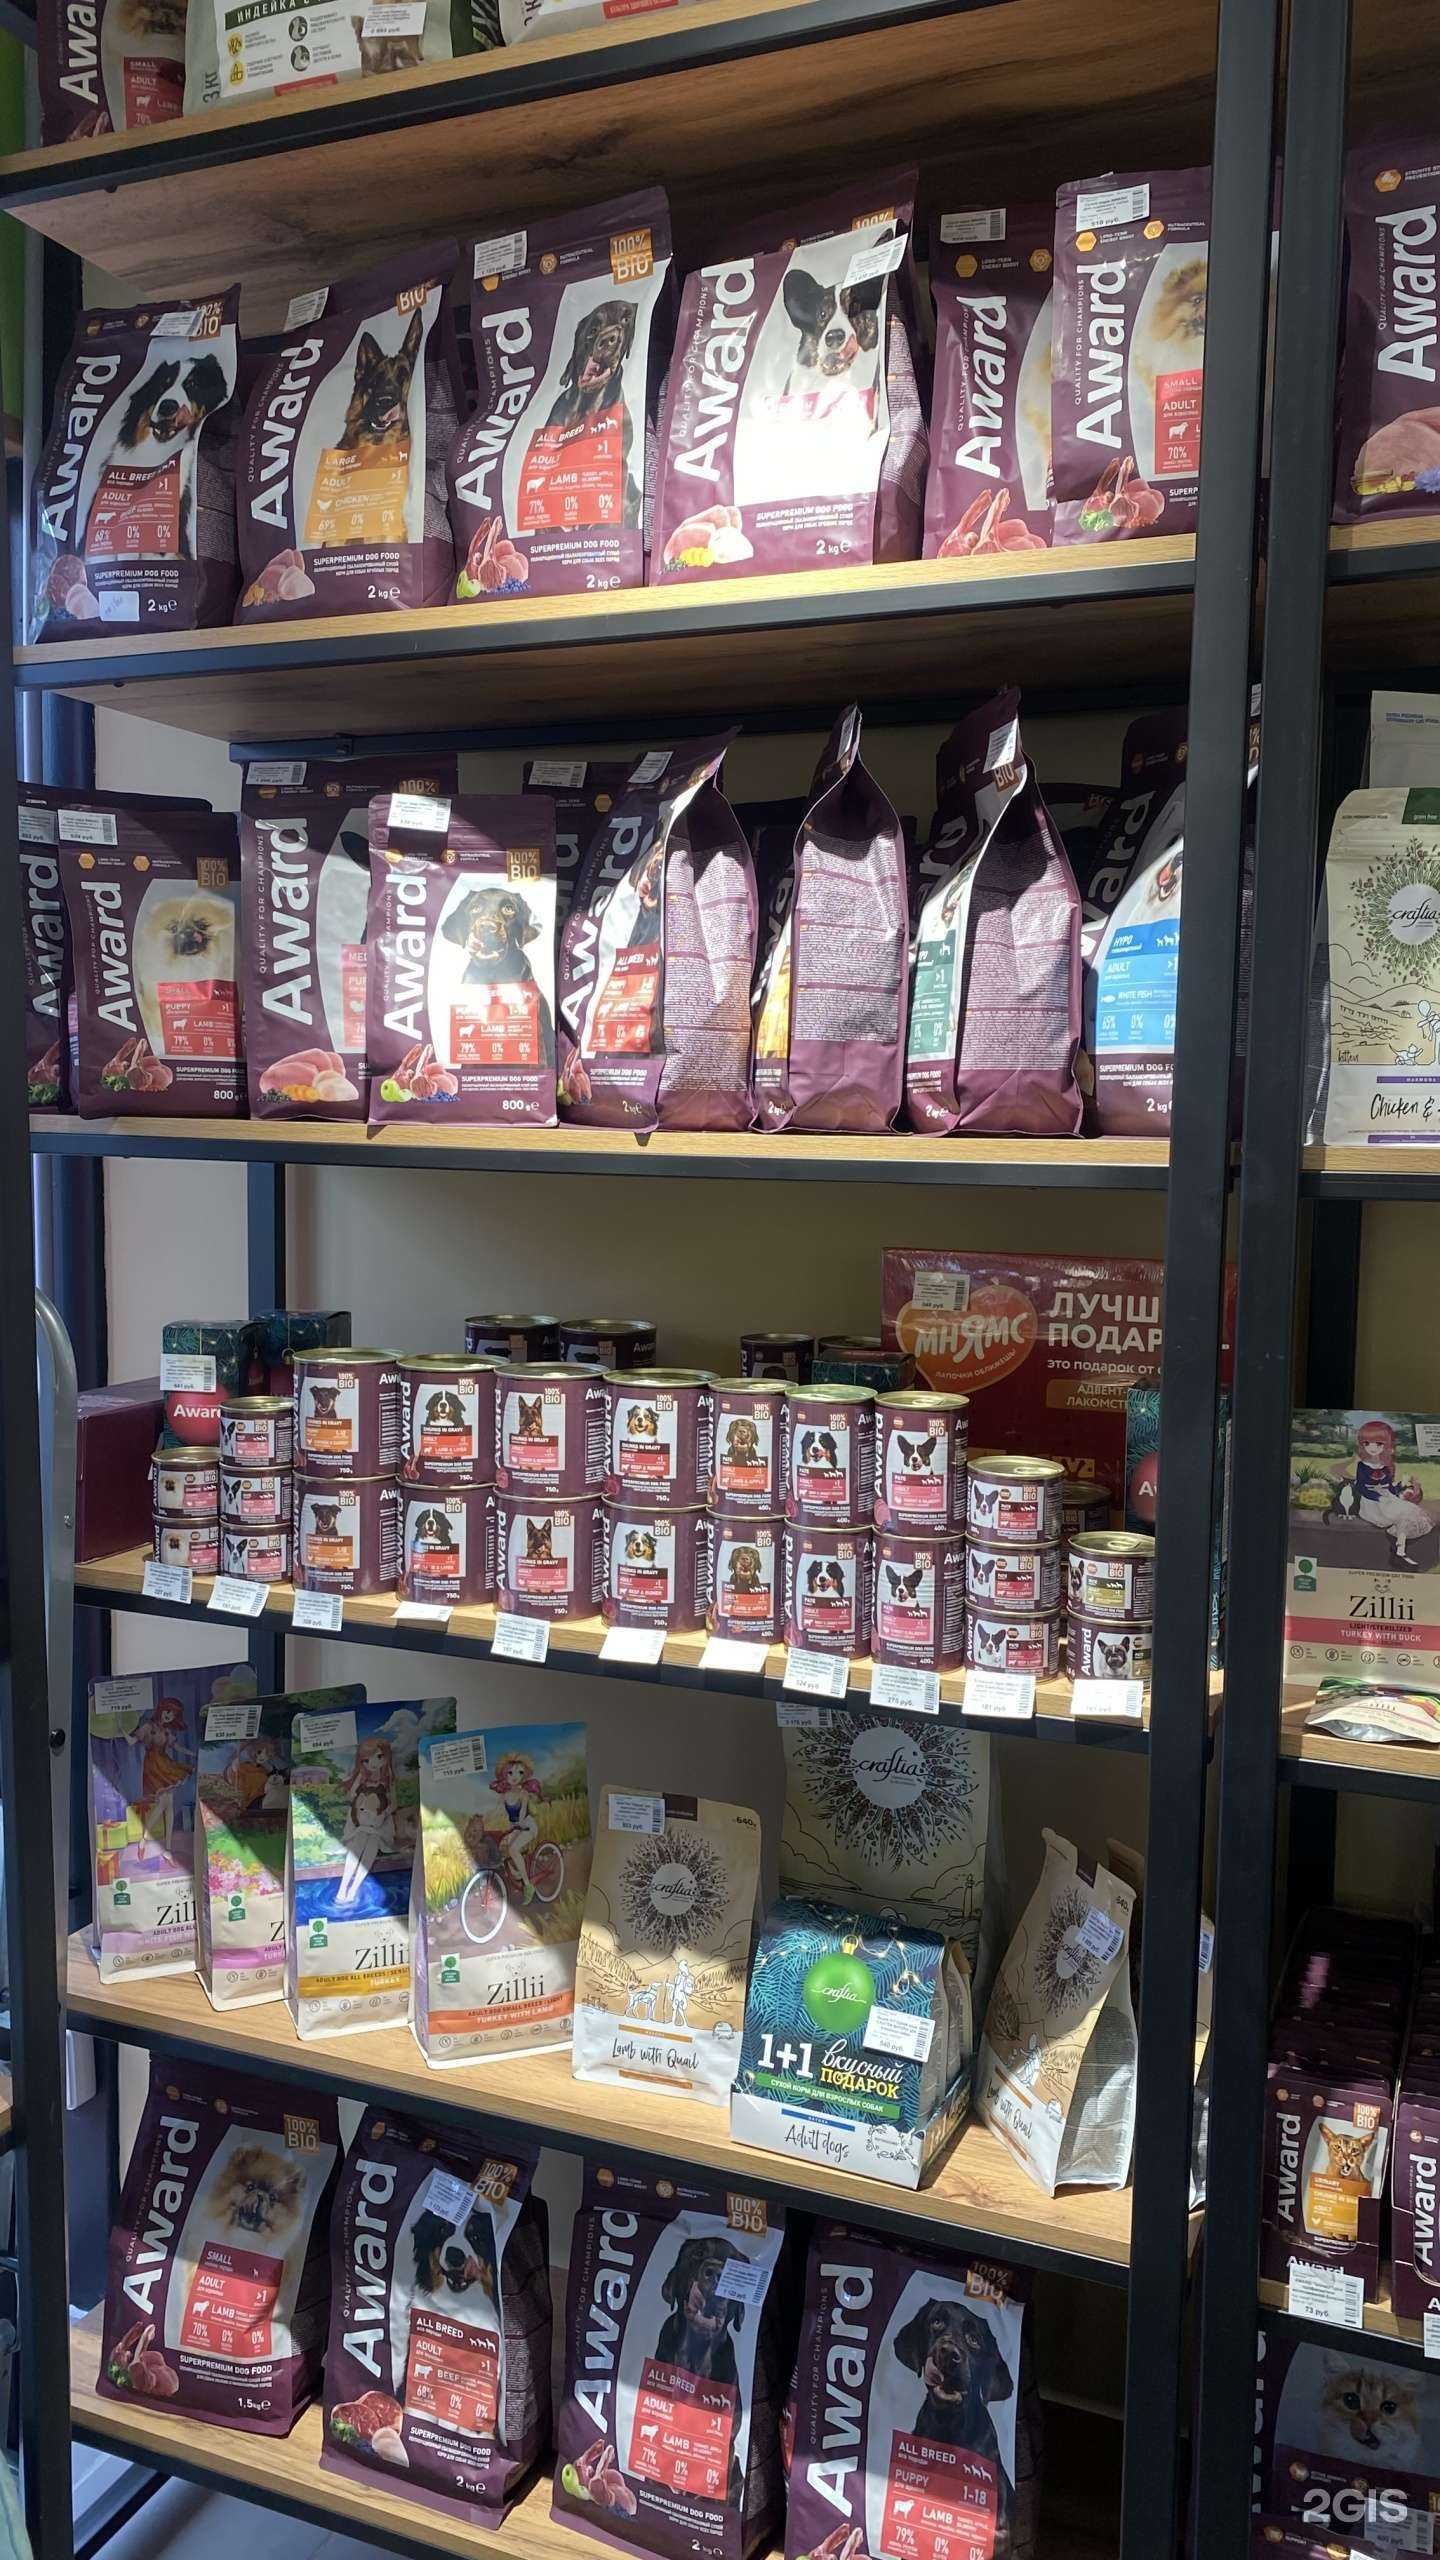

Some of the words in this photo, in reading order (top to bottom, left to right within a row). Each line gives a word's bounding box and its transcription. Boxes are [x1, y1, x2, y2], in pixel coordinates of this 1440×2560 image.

[237, 0, 297, 23] ИНДЕЙКА
[613, 232, 646, 255] 100%
[616, 254, 648, 280] BIO
[1375, 204, 1438, 382] Award
[1076, 279, 1084, 334] CHAMPIONS
[1076, 259, 1127, 449] Award
[673, 258, 755, 482] Award
[955, 296, 1007, 479] Award
[1074, 360, 1082, 405] QUALITY
[1164, 378, 1197, 388] SMALL
[455, 307, 535, 511] Award
[1163, 399, 1197, 411] ADULT
[251, 338, 324, 530] Award
[536, 432, 557, 444] ALL
[559, 424, 585, 441] BREED
[45, 355, 121, 542] Award
[1168, 446, 1187, 459] 70%
[530, 453, 560, 465] ADULT
[550, 473, 578, 486] LAMB
[101, 492, 132, 502] ADULT
[530, 541, 582, 554] SUPERPREMIUM
[583, 541, 598, 549] DOG
[600, 540, 620, 548] FOOD
[314, 554, 364, 566] SUPERPREMIUM
[365, 552, 379, 561] DOG
[380, 552, 400, 560] FOOD
[95, 570, 143, 580] SUPERPREMIUM
[160, 570, 179, 578] FOOD
[256, 834, 265, 893] CHAMPIONS
[510, 852, 540, 864] 100%
[200, 872, 226, 886] BIO
[511, 865, 538, 880] BIO
[255, 818, 313, 1026] Award
[1391, 898, 1440, 928] craftia
[560, 816, 642, 1030] Award
[1113, 935, 1134, 946] HYPO
[81, 881, 138, 1032] Award
[384, 873, 427, 1041] Award
[1107, 961, 1131, 973] ADULT
[1100, 1063, 1144, 1073] SUPERPREMIUM
[1146, 1063, 1163, 1072] DOG
[214, 1089, 233, 1100] 800
[502, 1100, 524, 1110] 800
[1370, 1094, 1418, 1120] Chicken
[914, 1312, 1031, 1364] МНЯМС
[458, 1385, 474, 1394] BIO
[545, 1395, 560, 1404] BIO
[656, 1401, 672, 1410] BIO
[754, 1411, 769, 1419] BIO
[830, 1421, 846, 1431] BIO
[929, 1427, 944, 1437] BIO
[339, 1497, 355, 1505] BIO
[446, 1504, 461, 1512] BIO
[554, 1517, 570, 1526] BIO
[654, 1527, 670, 1536] BIO
[757, 1538, 772, 1547] BIO
[837, 1550, 853, 1560] BIO
[915, 1560, 931, 1569] BIO
[1349, 1595, 1415, 1621] Zillii
[1341, 1630, 1374, 1639] TURKEY
[1376, 1632, 1396, 1640] WITH
[1398, 1634, 1422, 1642] DUCK
[1081, 1628, 1092, 1676] Award
[858, 1746, 931, 1782] craftia
[736, 1816, 753, 1826] 640
[655, 1877, 693, 1900] craftia
[486, 1970, 546, 2006] Zillii
[810, 1979, 866, 2003] craftia
[757, 2033, 814, 2079] 1+1
[820, 2038, 903, 2084] вкусный
[770, 2078, 792, 2091] СУХОЙ
[819, 2066, 900, 2099] ПОДАРОК
[1356, 2103, 1378, 2117] 100%
[286, 2116, 317, 2134] 100%
[1356, 2115, 1375, 2129] BIO
[287, 2133, 317, 2150] BIO
[483, 2161, 517, 2182] 100%
[1276, 2112, 1301, 2224] Award
[474, 2178, 507, 2199] BIO
[730, 2195, 762, 2215] 100%
[1409, 2153, 1438, 2267] Award
[123, 2115, 200, 2315] Award
[731, 2212, 763, 2232] BIO
[207, 2250, 232, 2265] SMALL
[343, 2158, 398, 2378] Award
[199, 2275, 225, 2289] ADULT
[211, 2303, 235, 2319] LAMB
[574, 2206, 640, 2434] Award
[416, 2317, 434, 2329] ALL
[435, 2321, 464, 2339] BREED
[813, 2286, 829, 2363] CHAMPIONS
[416, 2339, 443, 2356] ADULT
[179, 2354, 234, 2373] SUPERPREMIUM
[234, 2364, 250, 2375] DOG
[251, 2364, 272, 2375] FOOD
[648, 2368, 668, 2384] ALL
[669, 2375, 696, 2394] BREED
[807, 2263, 874, 2518] Award
[416, 2384, 434, 2400] 68%
[449, 2394, 462, 2410] 0%
[475, 2403, 488, 2419] 0%
[643, 2396, 675, 2413] ADULT
[410, 2426, 459, 2448] SUPERPREMIUM
[459, 2442, 472, 2452] DOG
[472, 2444, 491, 2457] FOOD
[662, 2431, 690, 2450] LAMB
[898, 2442, 919, 2459] ALL
[921, 2447, 957, 2465] BREED
[674, 2459, 688, 2475] 0%
[706, 2468, 719, 2485] 0%
[895, 2468, 930, 2487] PUPPY
[962, 2485, 987, 2505] 1-18
[639, 2489, 689, 2514] SUPERPREMIUM
[689, 2507, 704, 2519] DOG
[704, 2512, 724, 2522] FOOD
[922, 2506, 953, 2524] LAMB
[896, 2526, 915, 2545] 79%
[934, 2536, 950, 2555] 0%
